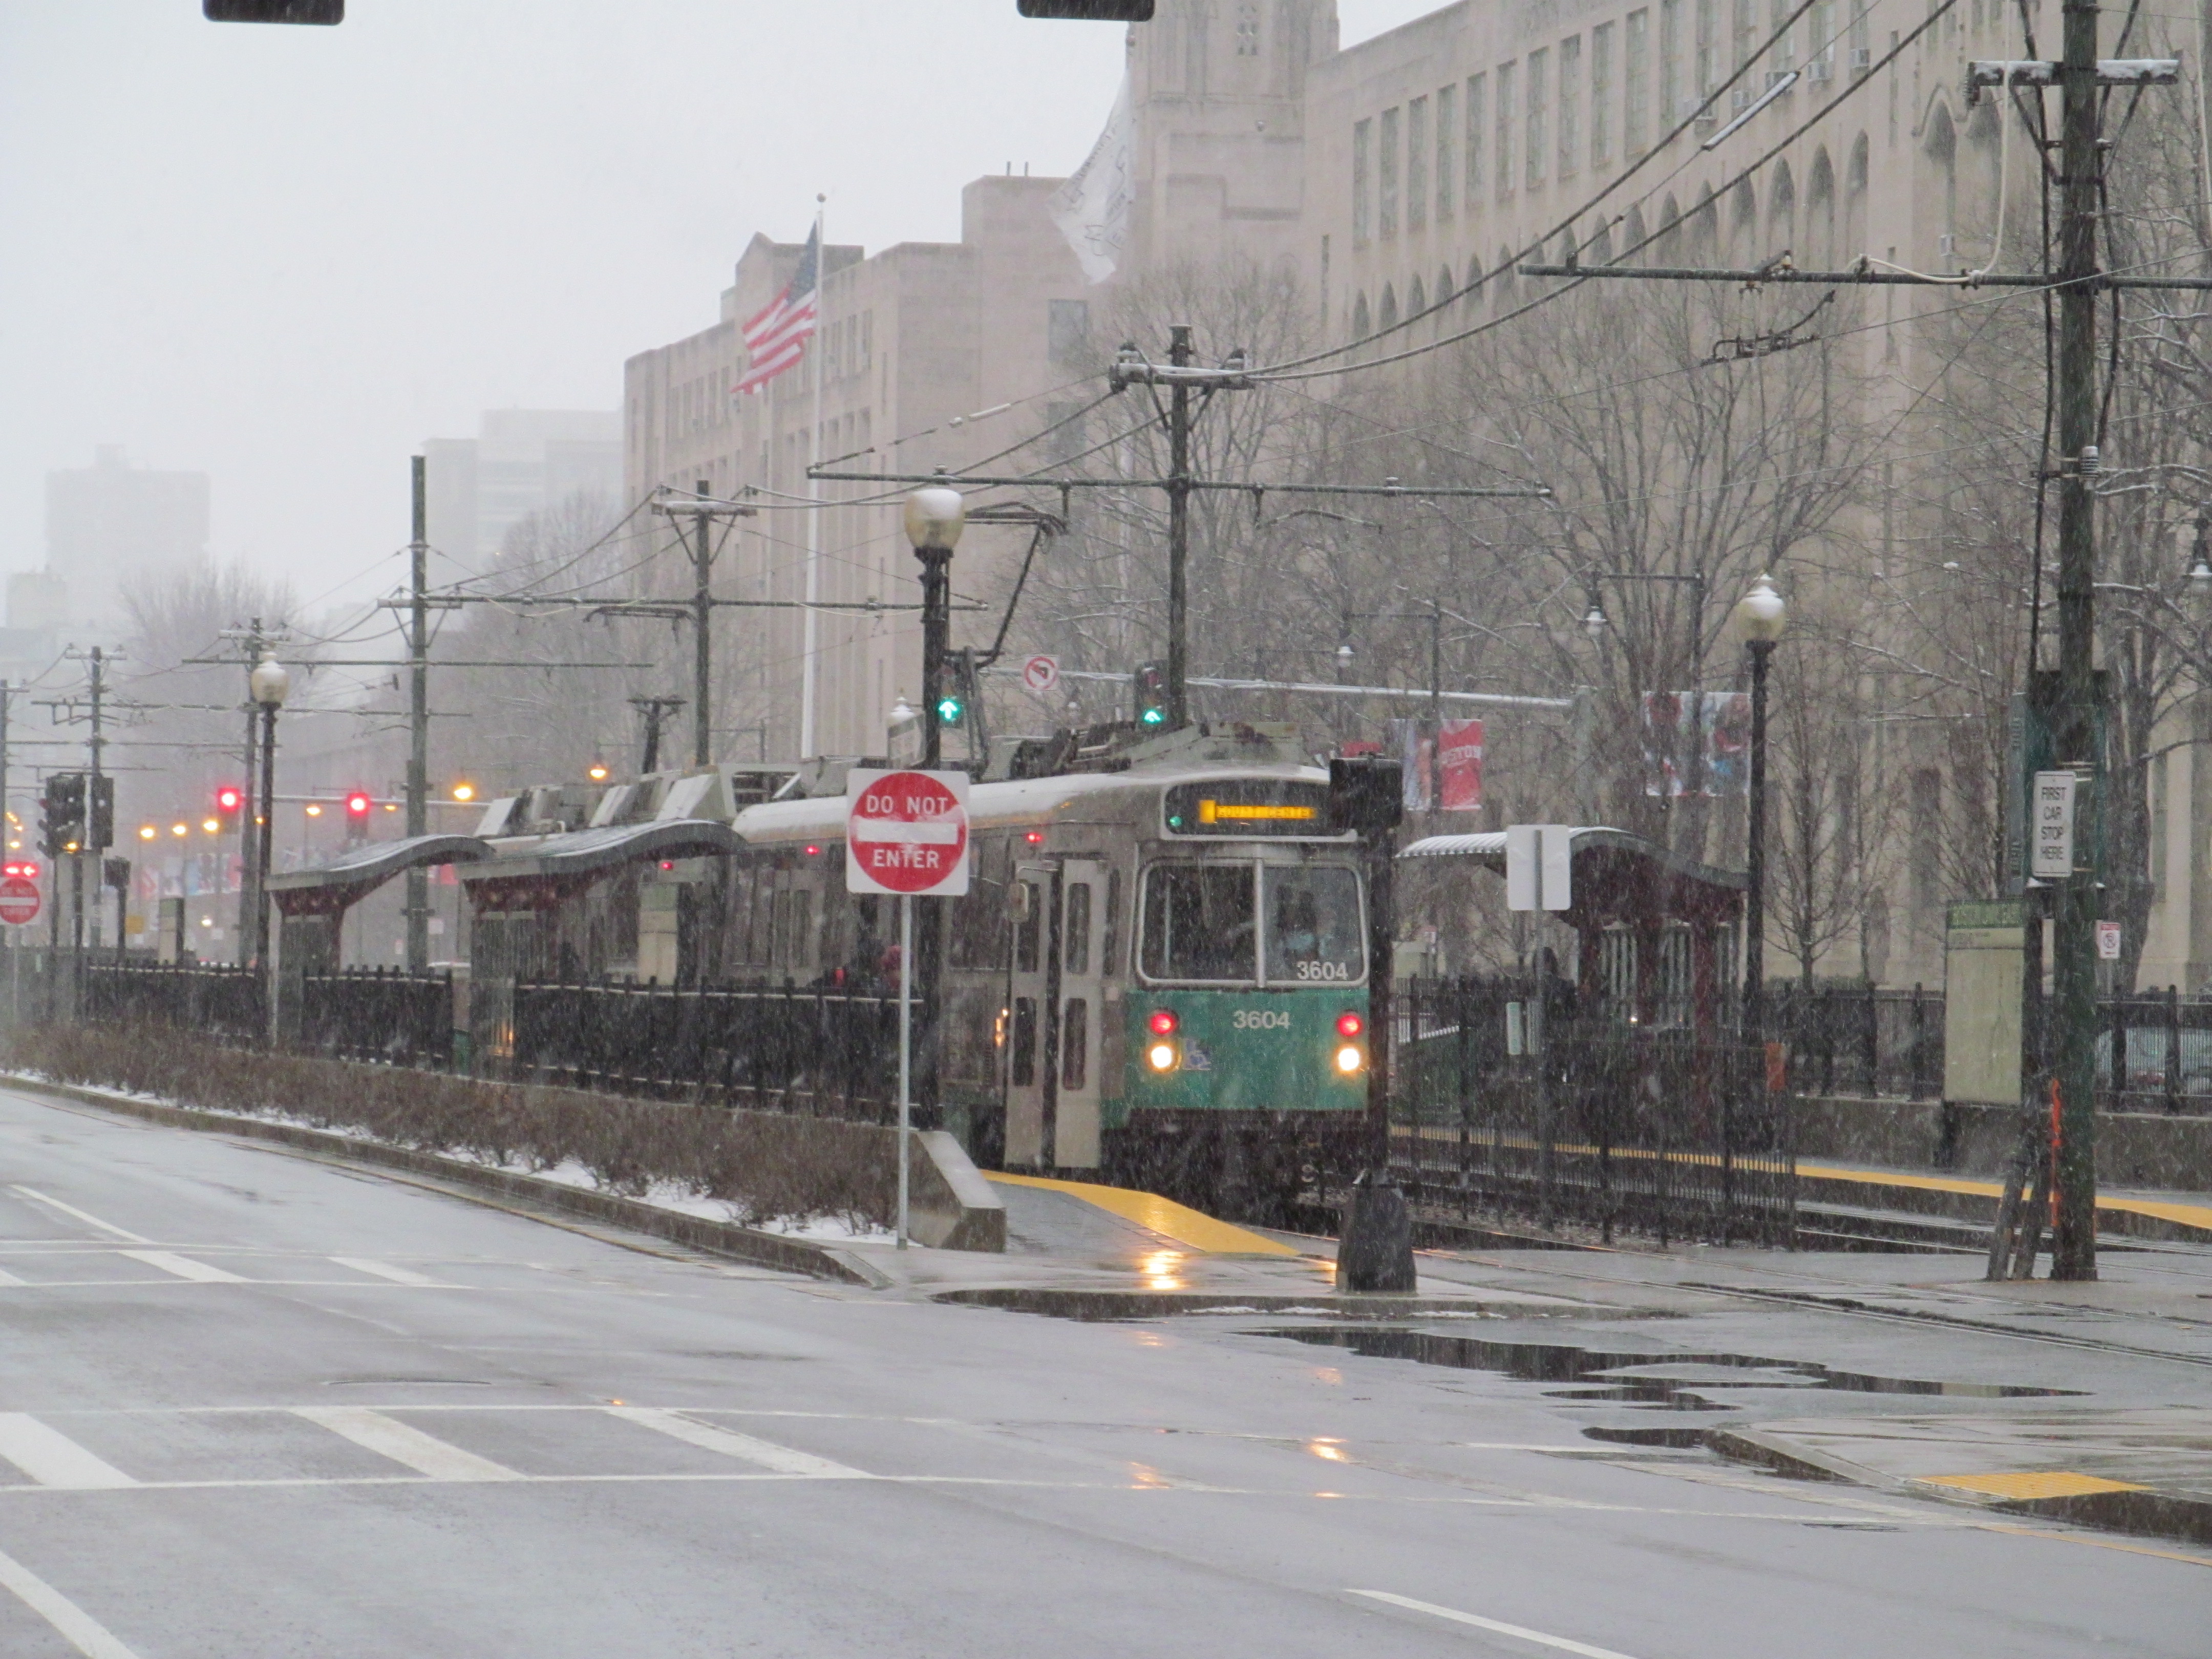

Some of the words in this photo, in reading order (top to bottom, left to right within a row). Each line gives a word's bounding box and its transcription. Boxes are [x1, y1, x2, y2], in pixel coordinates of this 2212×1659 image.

[2041, 786, 2067, 801] FIRST
[867, 795, 894, 813] DO
[907, 796, 948, 815] NOT
[2044, 806, 2062, 820] CAR
[2041, 826, 2064, 840] STOP
[873, 849, 939, 868] ENTER
[2040, 846, 2065, 860] HERE
[1296, 961, 1349, 980] 3604
[1232, 1010, 1290, 1029] 3604
